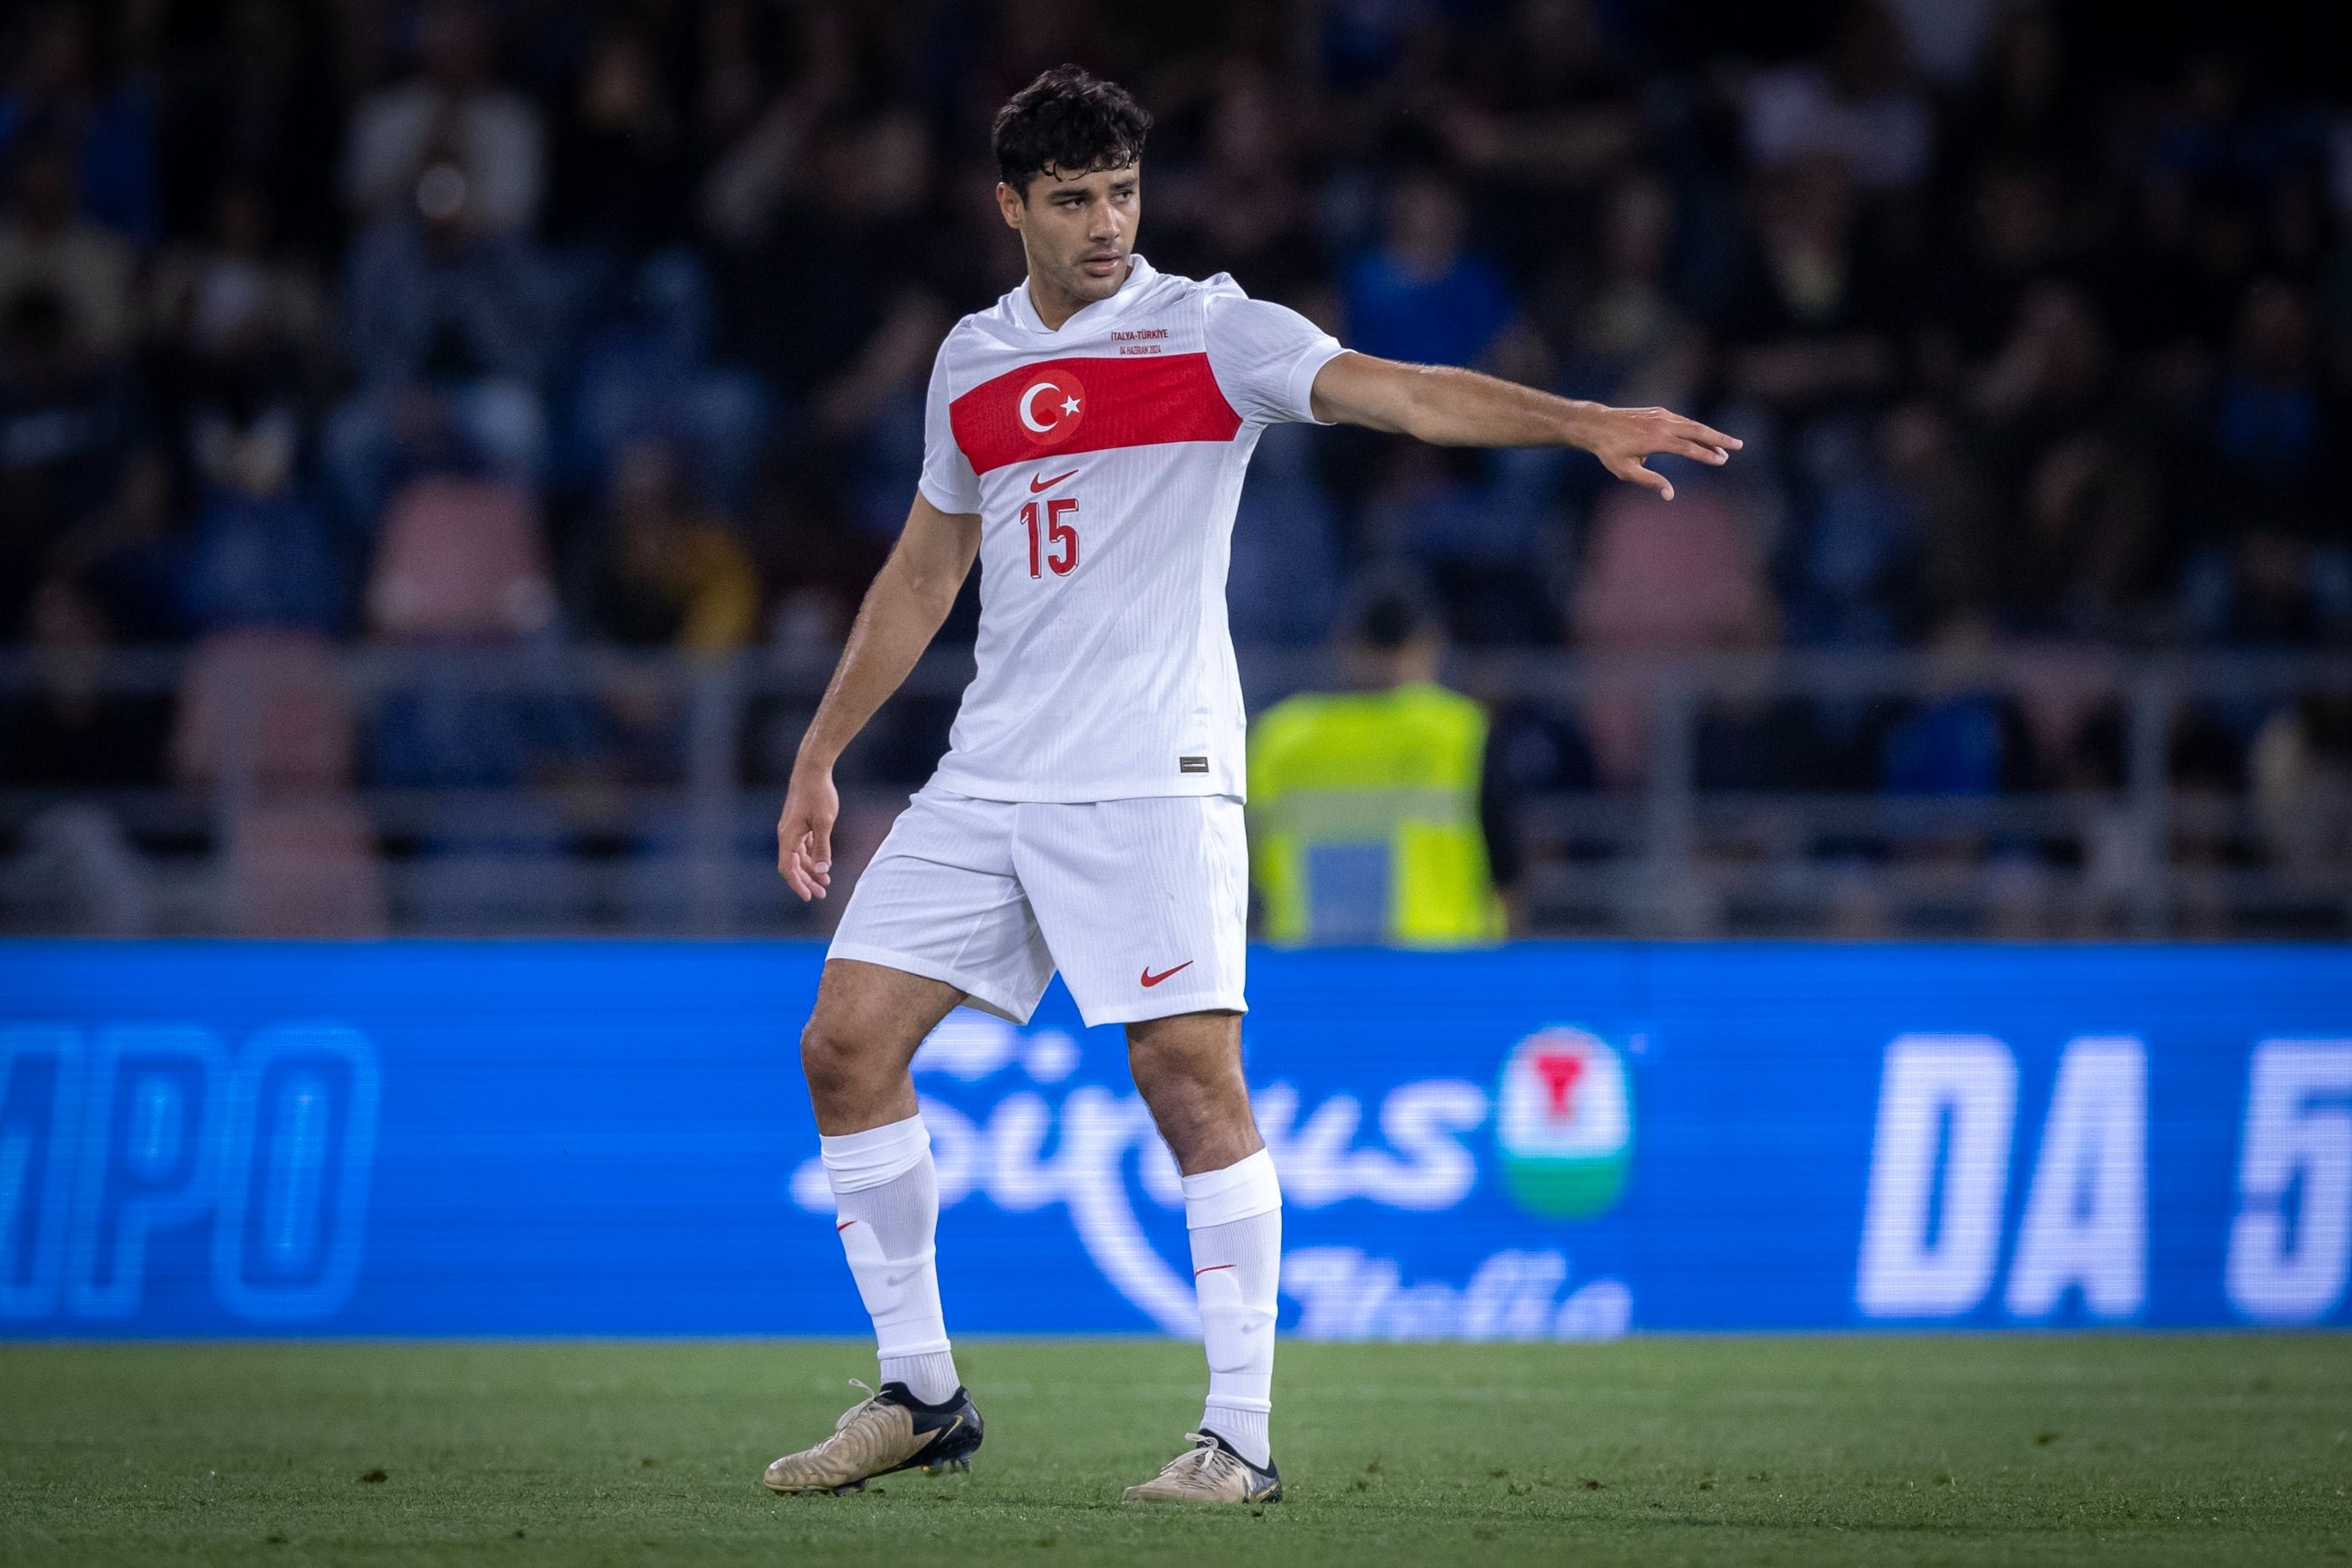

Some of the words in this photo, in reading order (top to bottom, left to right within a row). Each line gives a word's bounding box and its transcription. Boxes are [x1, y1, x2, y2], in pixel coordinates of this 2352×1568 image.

[1111, 329, 1169, 341] İTALYA-TÜRKİYE
[1020, 499, 1079, 579] 15
[1856, 1032, 2148, 1317] DA
[2225, 1037, 2352, 1322] 5
